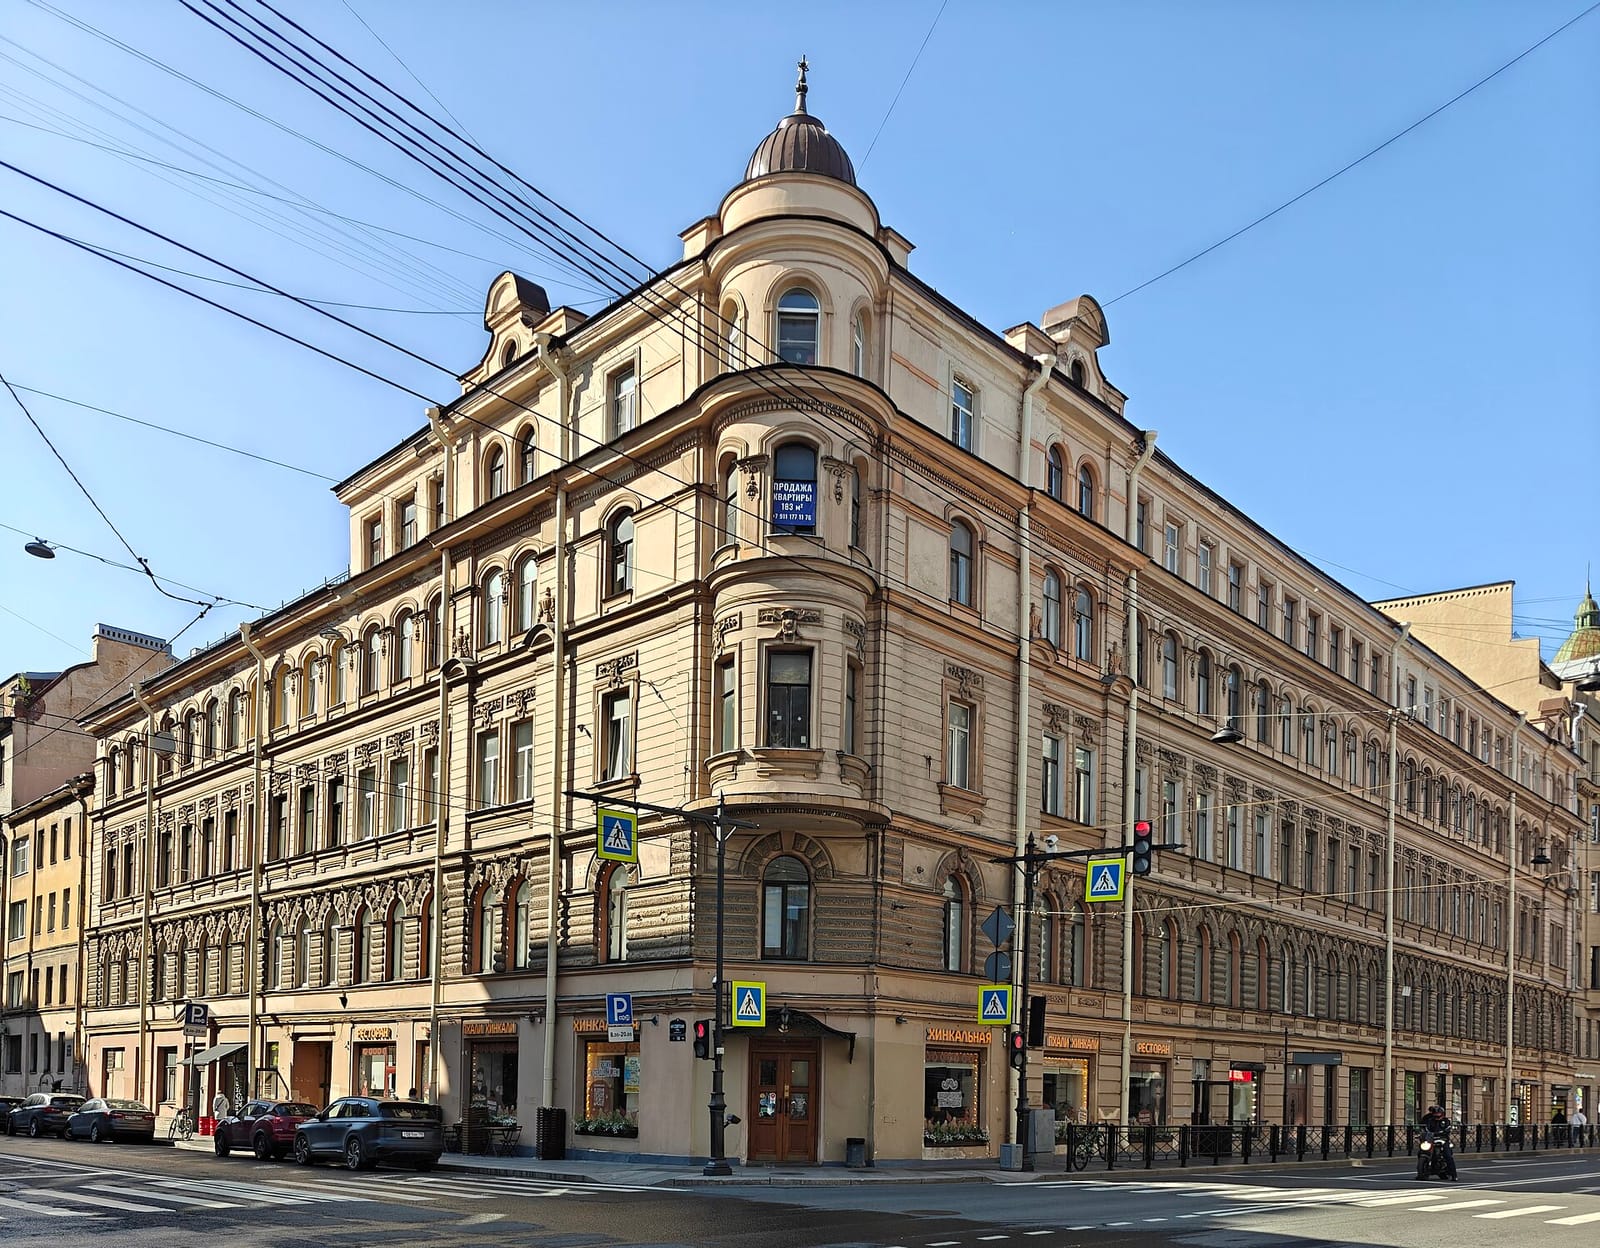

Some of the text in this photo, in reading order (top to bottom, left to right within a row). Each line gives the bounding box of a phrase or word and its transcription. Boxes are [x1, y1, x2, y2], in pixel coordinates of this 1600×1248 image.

[773, 483, 812, 493] ПРОДАЖА
[773, 493, 812, 502] КВАРТИРЫ
[191, 1005, 204, 1023] P
[613, 997, 628, 1022] P
[573, 1018, 640, 1032] ХИНКАЯ
[357, 1028, 390, 1039] РЕСТОРАН
[928, 1028, 992, 1043] ХИНКАЛЬНАЯ
[1136, 1042, 1169, 1055] РЕСТОРАН
